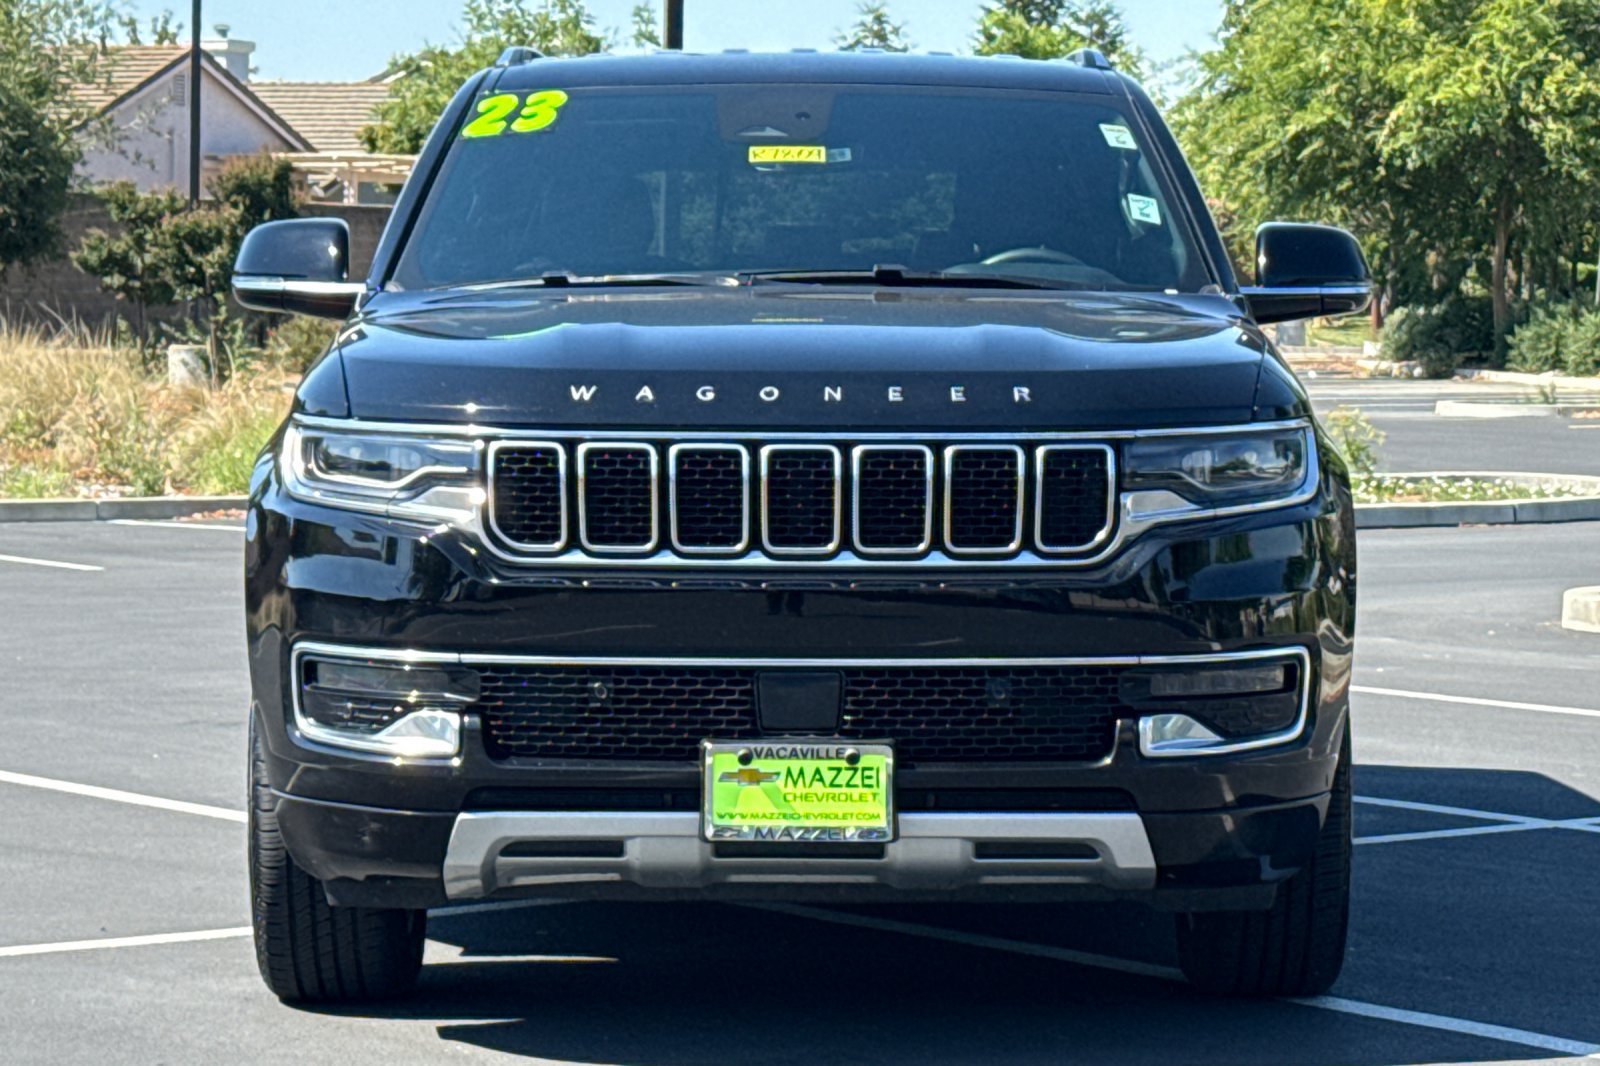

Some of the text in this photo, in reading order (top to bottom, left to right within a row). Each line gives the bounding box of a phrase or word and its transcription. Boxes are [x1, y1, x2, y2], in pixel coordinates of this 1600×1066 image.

[462, 90, 568, 137] 23
[570, 384, 1031, 401] WAGONEER
[752, 746, 846, 759] VACAVILLE
[784, 766, 880, 788] MAZZEI
[783, 792, 879, 803] CHEVROLET
[716, 811, 881, 821] WWW.MAZZEICHEVROLET.COM
[754, 826, 851, 841] MAZZEI
